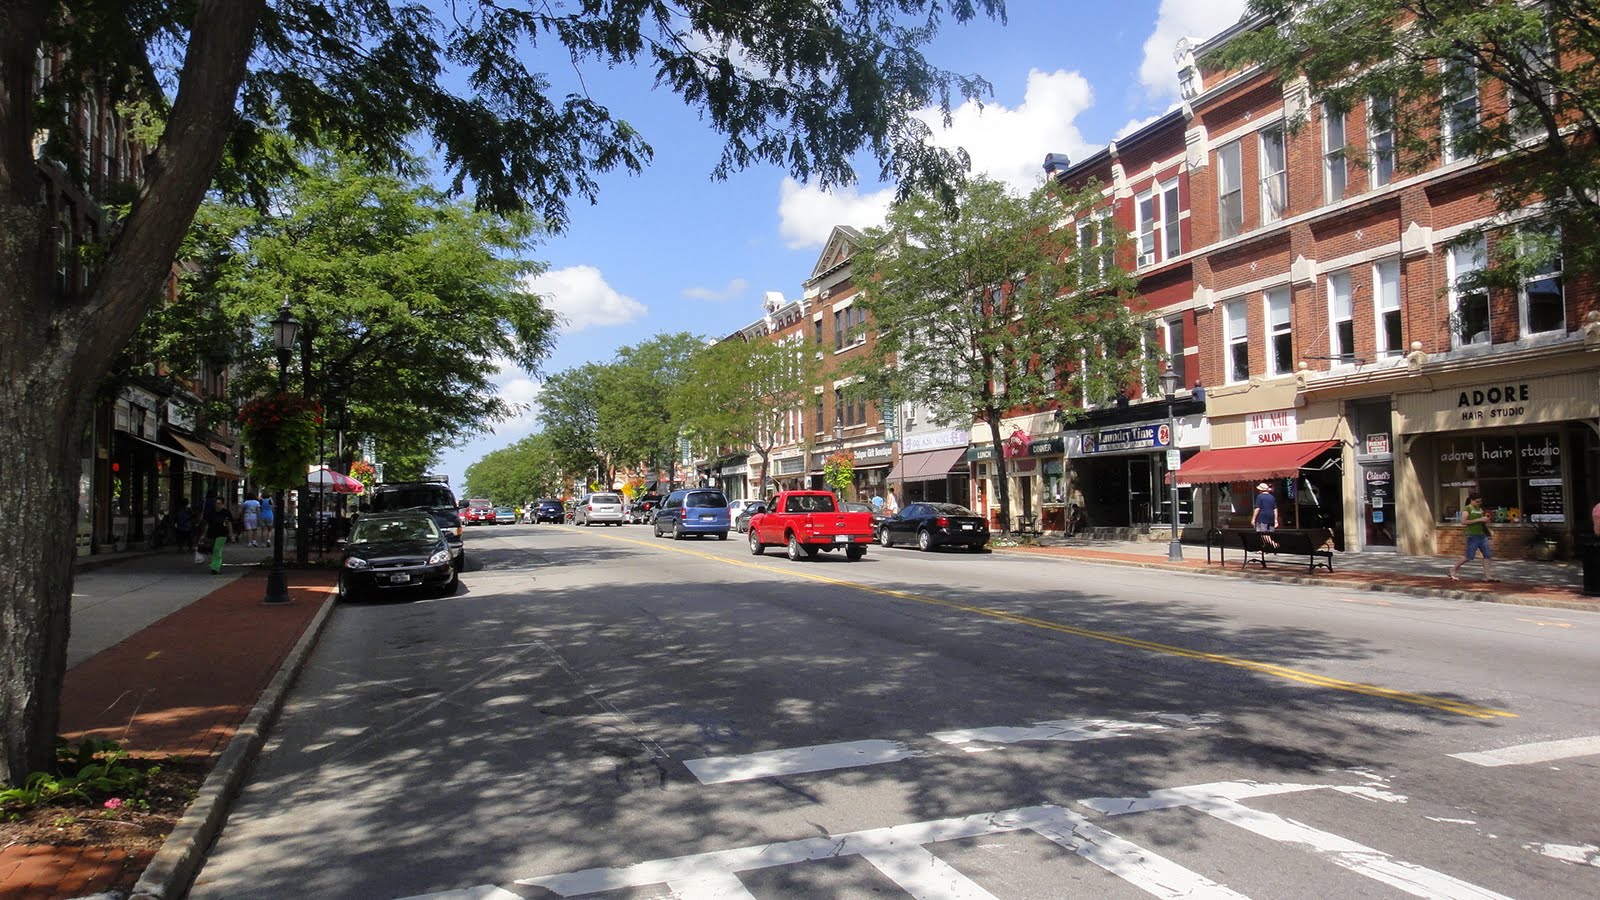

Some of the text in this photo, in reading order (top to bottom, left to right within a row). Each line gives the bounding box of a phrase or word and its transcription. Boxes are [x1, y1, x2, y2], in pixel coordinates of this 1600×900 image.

[1458, 384, 1529, 407] ADORE
[1251, 411, 1288, 429] MY NAIL
[1462, 406, 1525, 420] HAIR STUDIO
[1098, 427, 1154, 444] Laundry Time
[1160, 429, 1169, 440] 24
[1258, 433, 1283, 443] SALON
[977, 451, 992, 459] LUNCH
[1033, 443, 1052, 453] DINNER
[1441, 437, 1560, 461] adore hair studio
